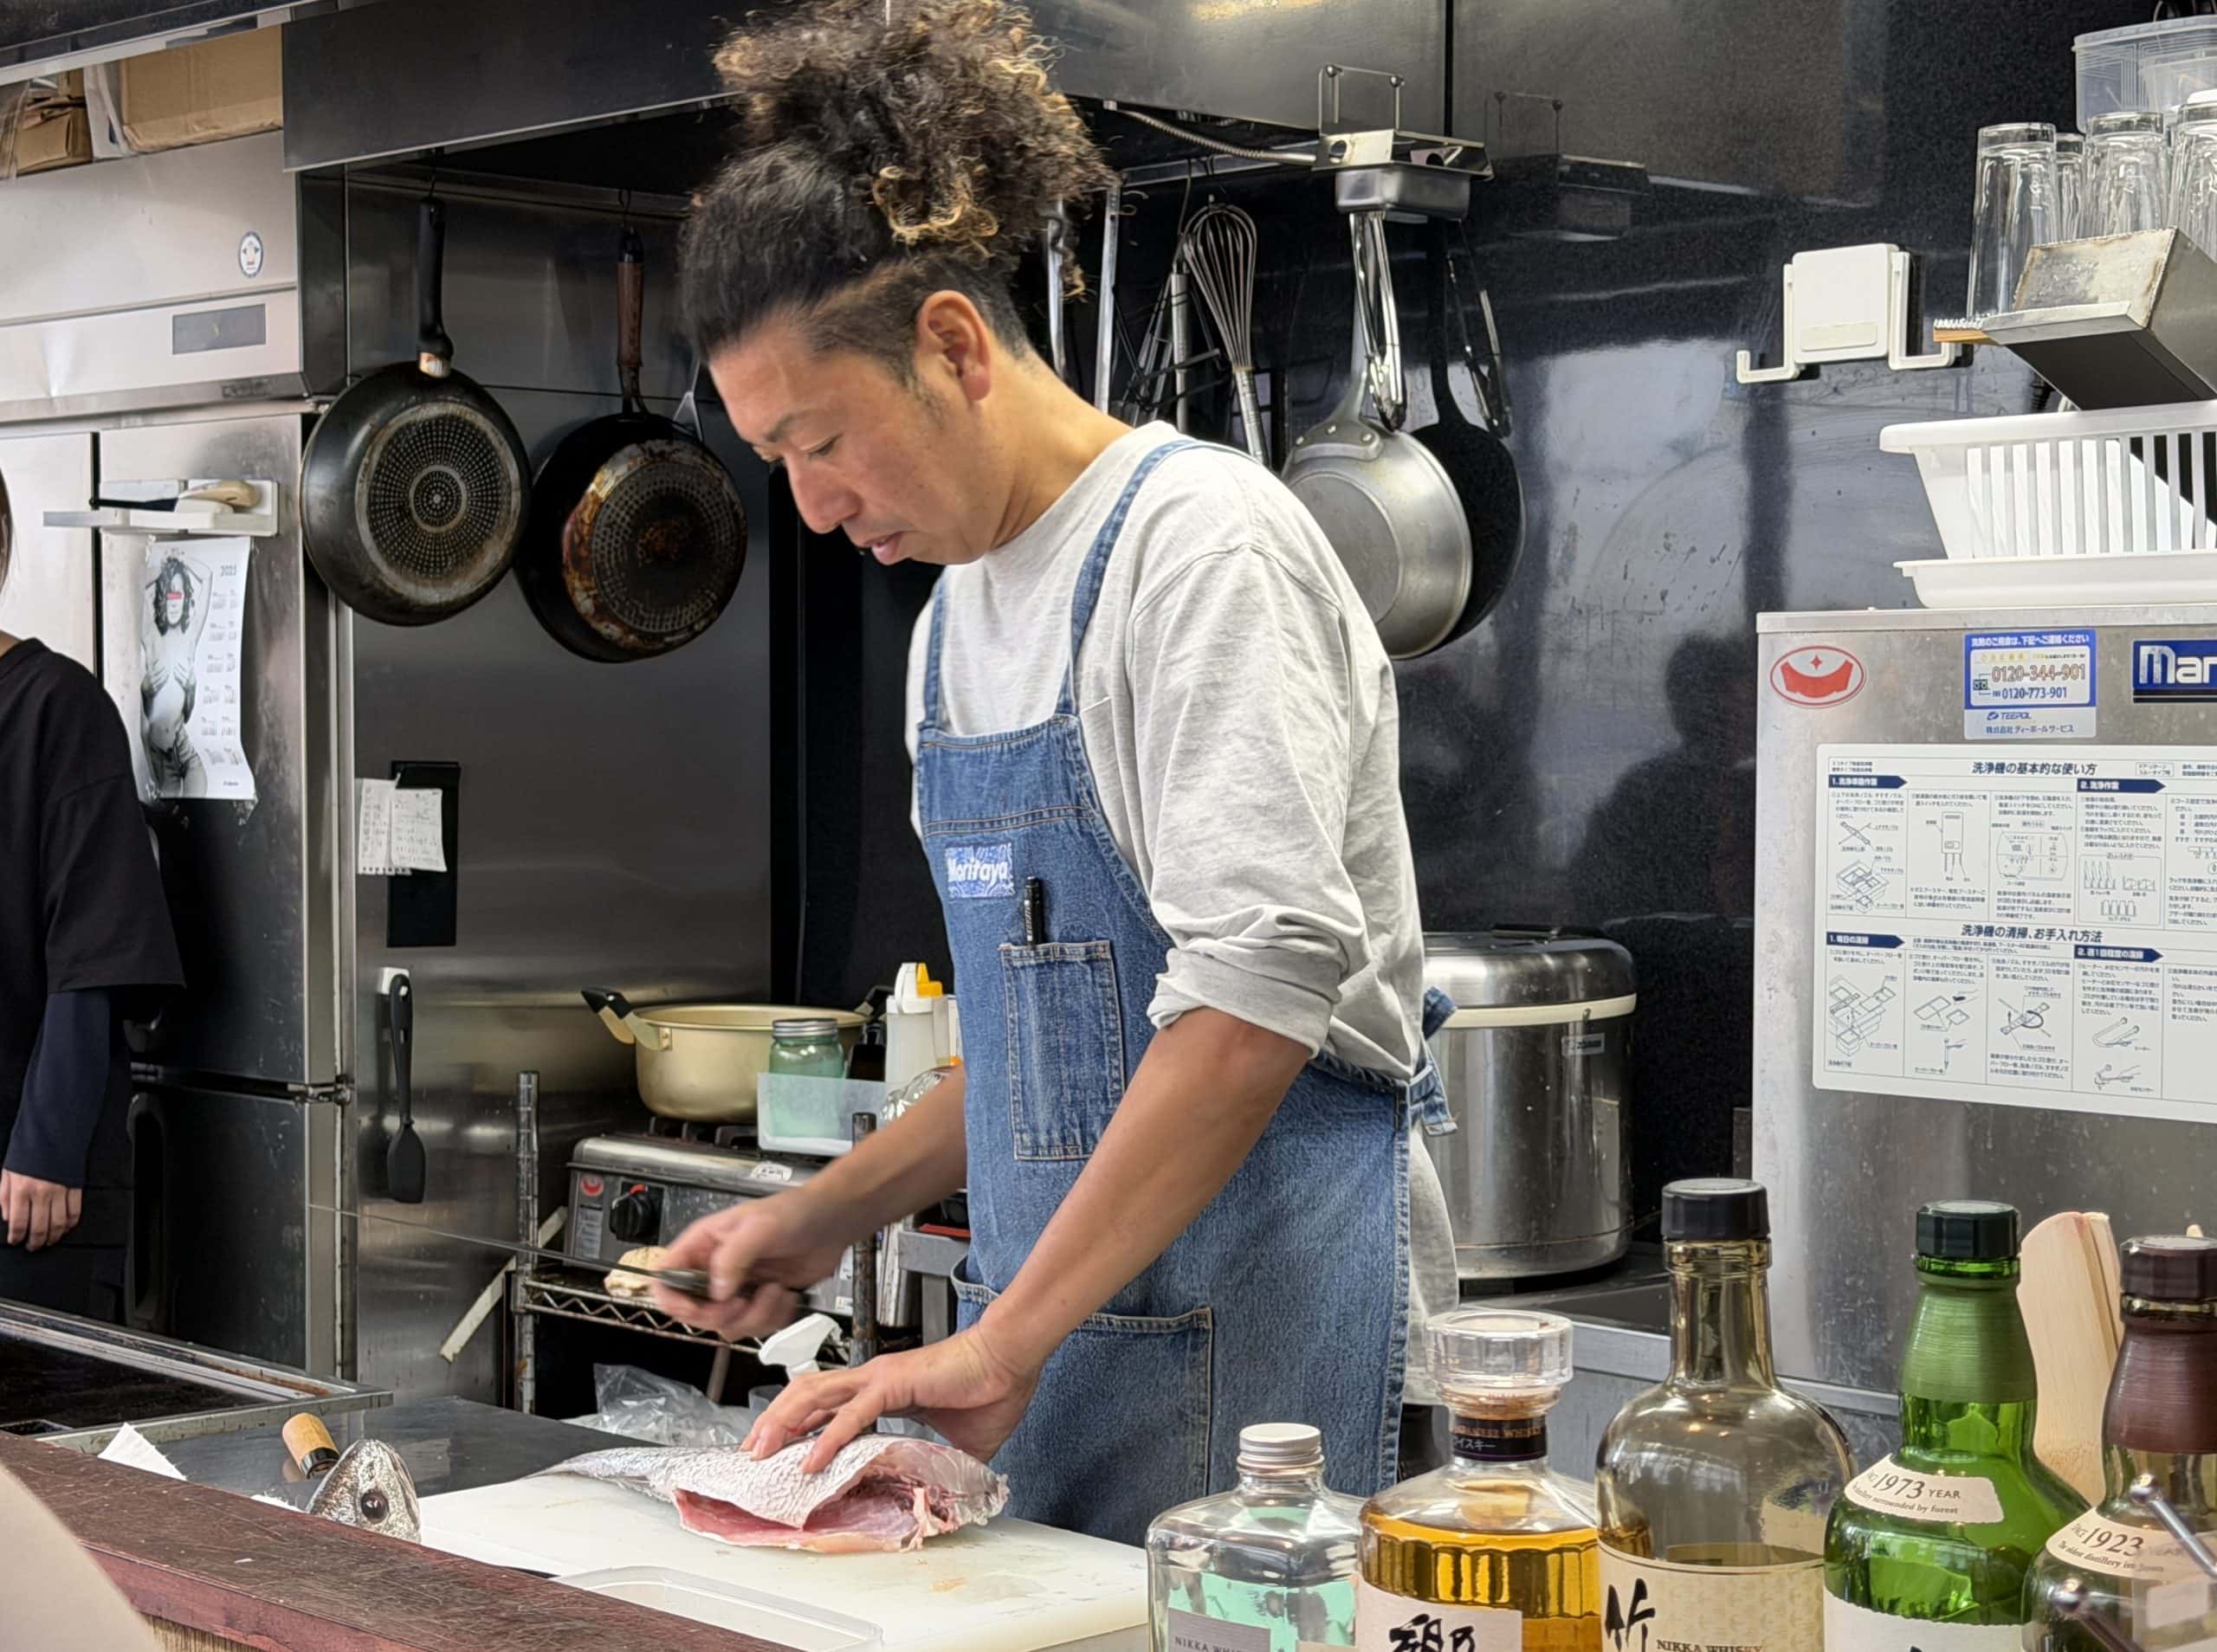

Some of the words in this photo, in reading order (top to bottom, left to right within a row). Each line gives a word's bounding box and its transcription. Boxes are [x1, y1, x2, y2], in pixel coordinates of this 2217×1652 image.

[1991, 663, 2085, 682] 0120-344-901
[2002, 687, 2067, 700] 0120-773-901
[1972, 761, 2097, 776] 洗浄機の基本的な使い方
[1962, 924, 2103, 943] 洗浄機の清掃、お手入れ方法
[1872, 1473, 1926, 1500] 1973
[1929, 1488, 1962, 1500] YEAR
[1871, 1497, 1916, 1511] surrounded
[1917, 1504, 1928, 1513] by
[1931, 1504, 1959, 1514] forest
[2081, 1527, 2144, 1557] 1923
[2084, 1552, 2122, 1569] distillery
[1174, 1636, 1209, 1652] NIKKA
[1656, 1639, 1703, 1652] NIKKA
